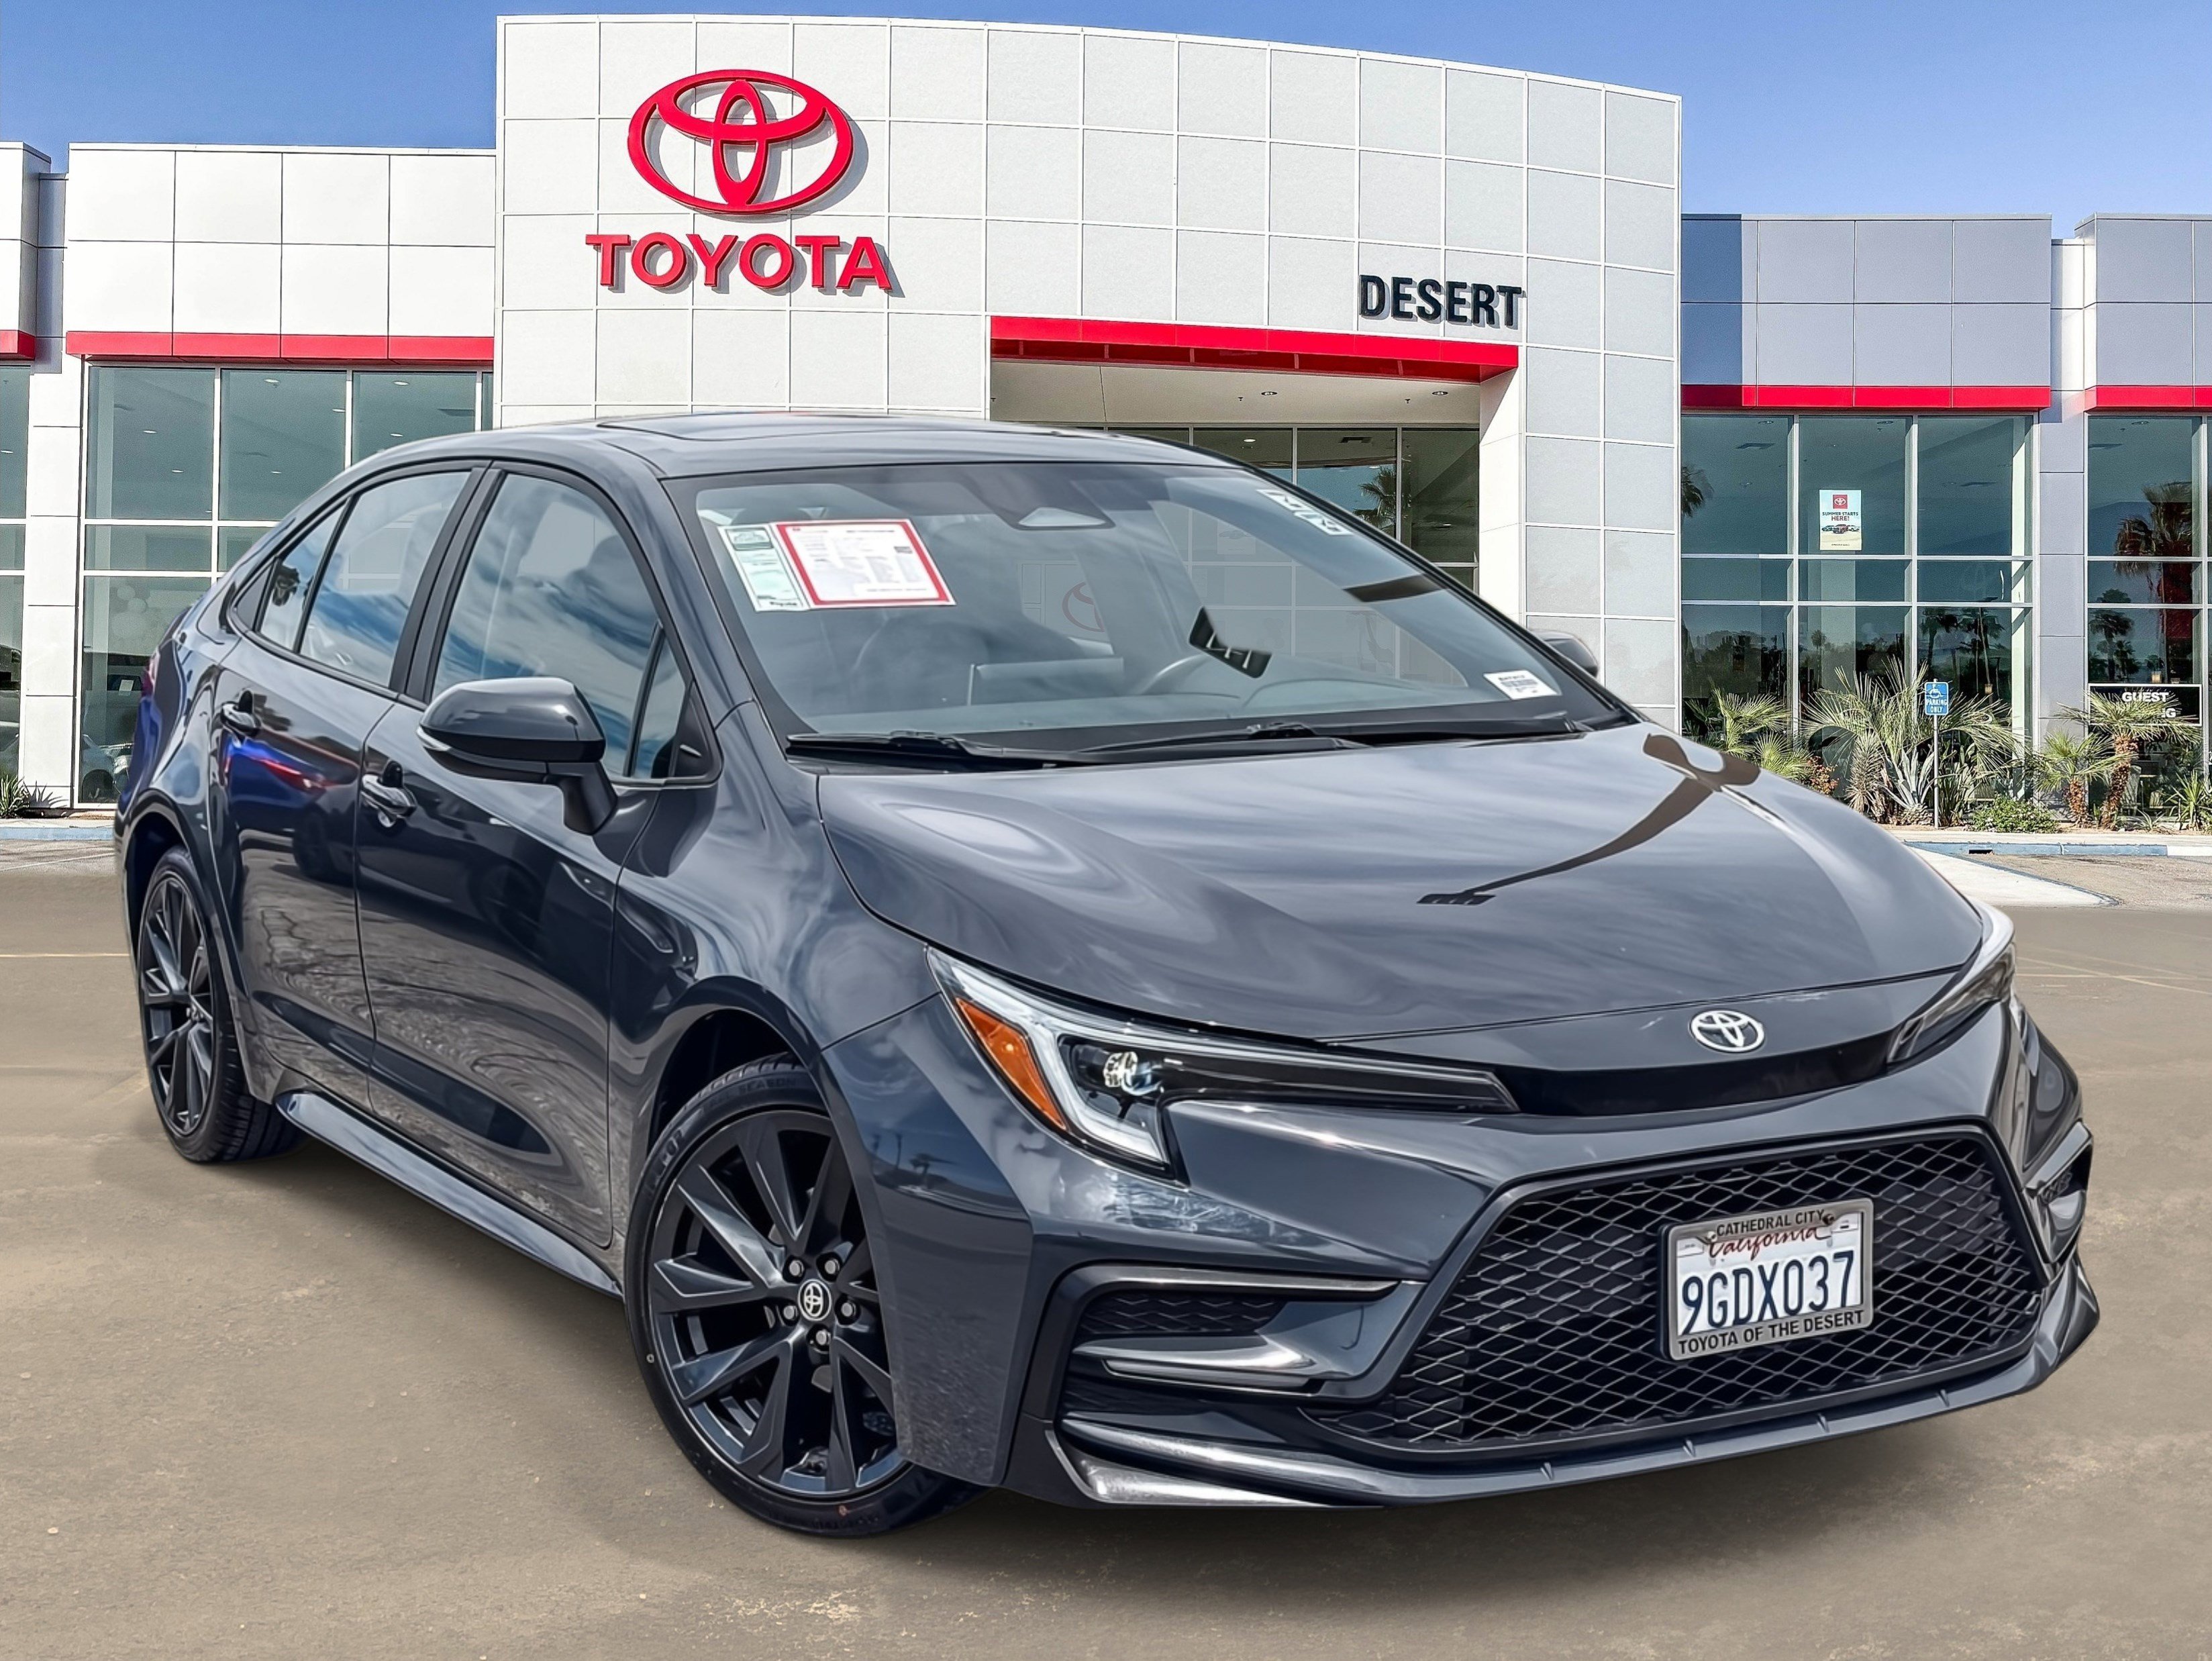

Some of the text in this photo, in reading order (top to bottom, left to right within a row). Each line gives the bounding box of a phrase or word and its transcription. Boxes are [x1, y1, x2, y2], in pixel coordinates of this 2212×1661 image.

[586, 232, 891, 290] TOYOTA
[1359, 274, 1522, 326] DESERT
[2121, 692, 2169, 703] GUEST
[1709, 1227, 1831, 1261] California
[1717, 1209, 1824, 1236] CATHEDRAL CITY
[1681, 1250, 1854, 1336] 9GDX037
[1680, 1309, 1864, 1354] TOYOTA OF THE DESERT
